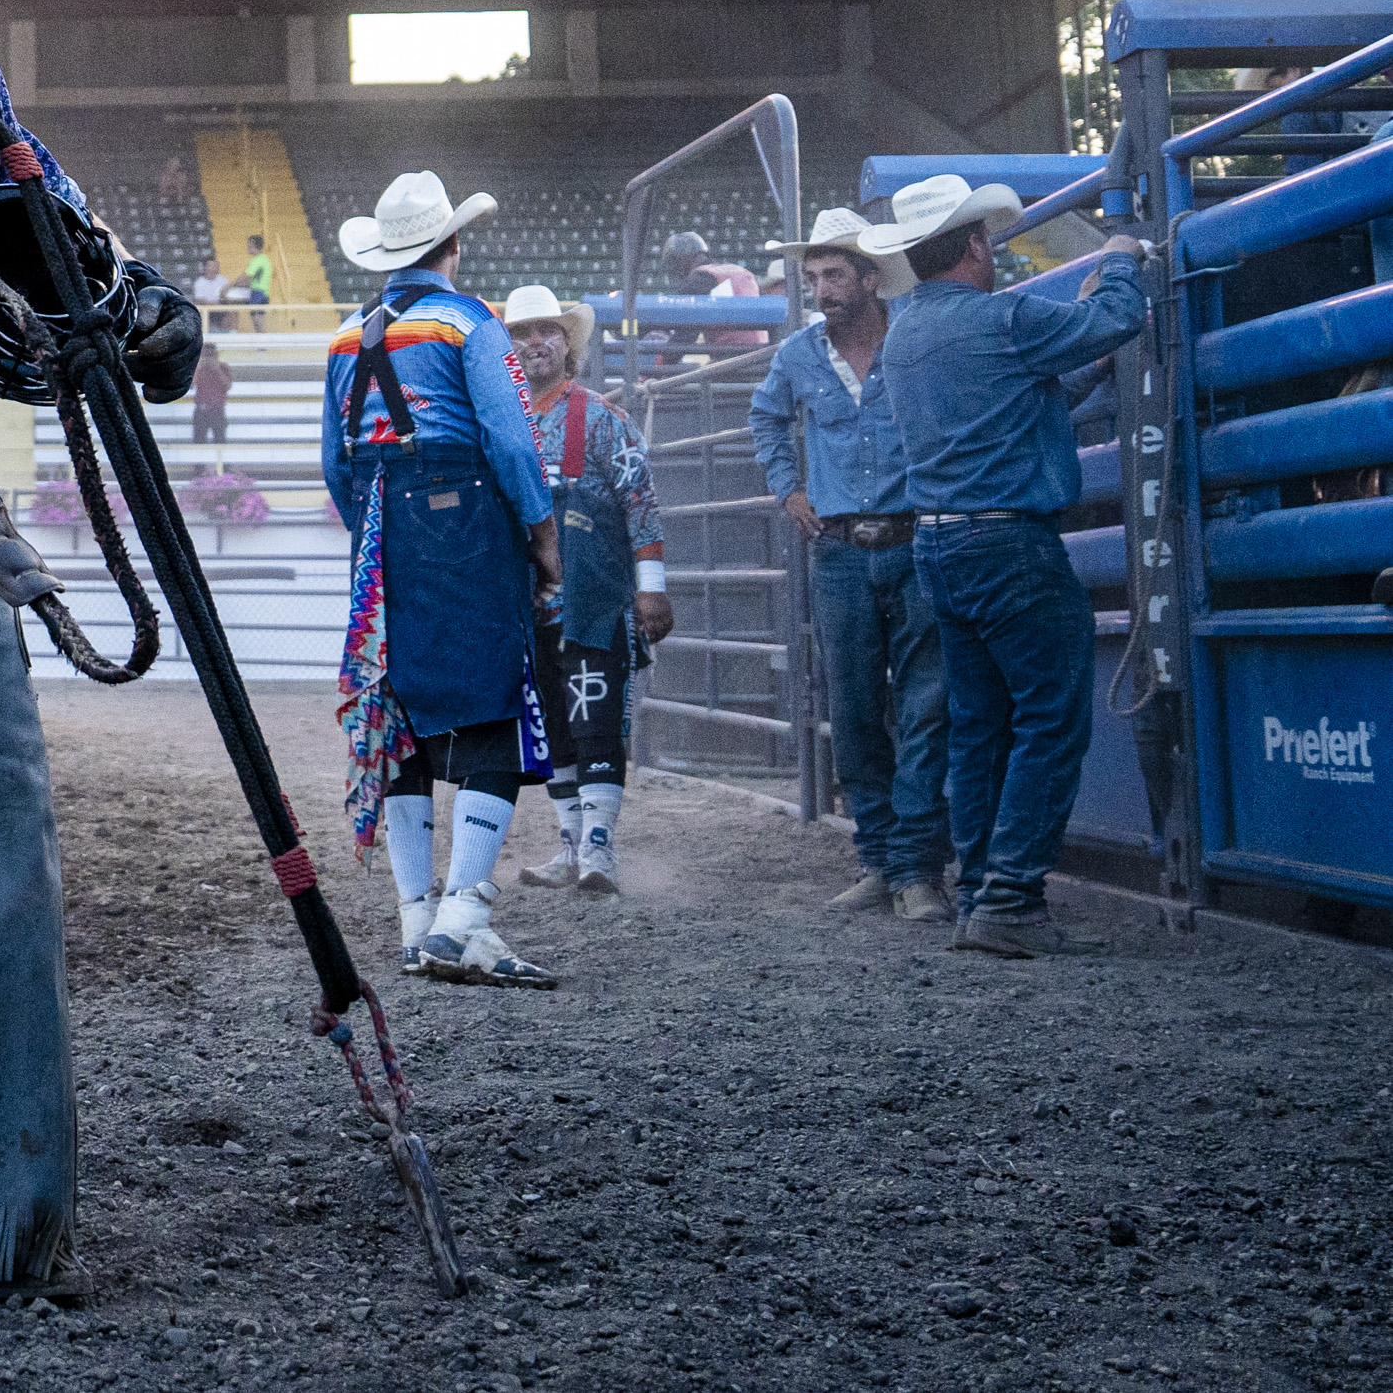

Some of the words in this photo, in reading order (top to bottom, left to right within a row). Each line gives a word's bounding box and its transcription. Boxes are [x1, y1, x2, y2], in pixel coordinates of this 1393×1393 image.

[501, 350, 528, 386] WM
[1263, 715, 1373, 767] Priefert
[464, 814, 499, 833] PUMA
